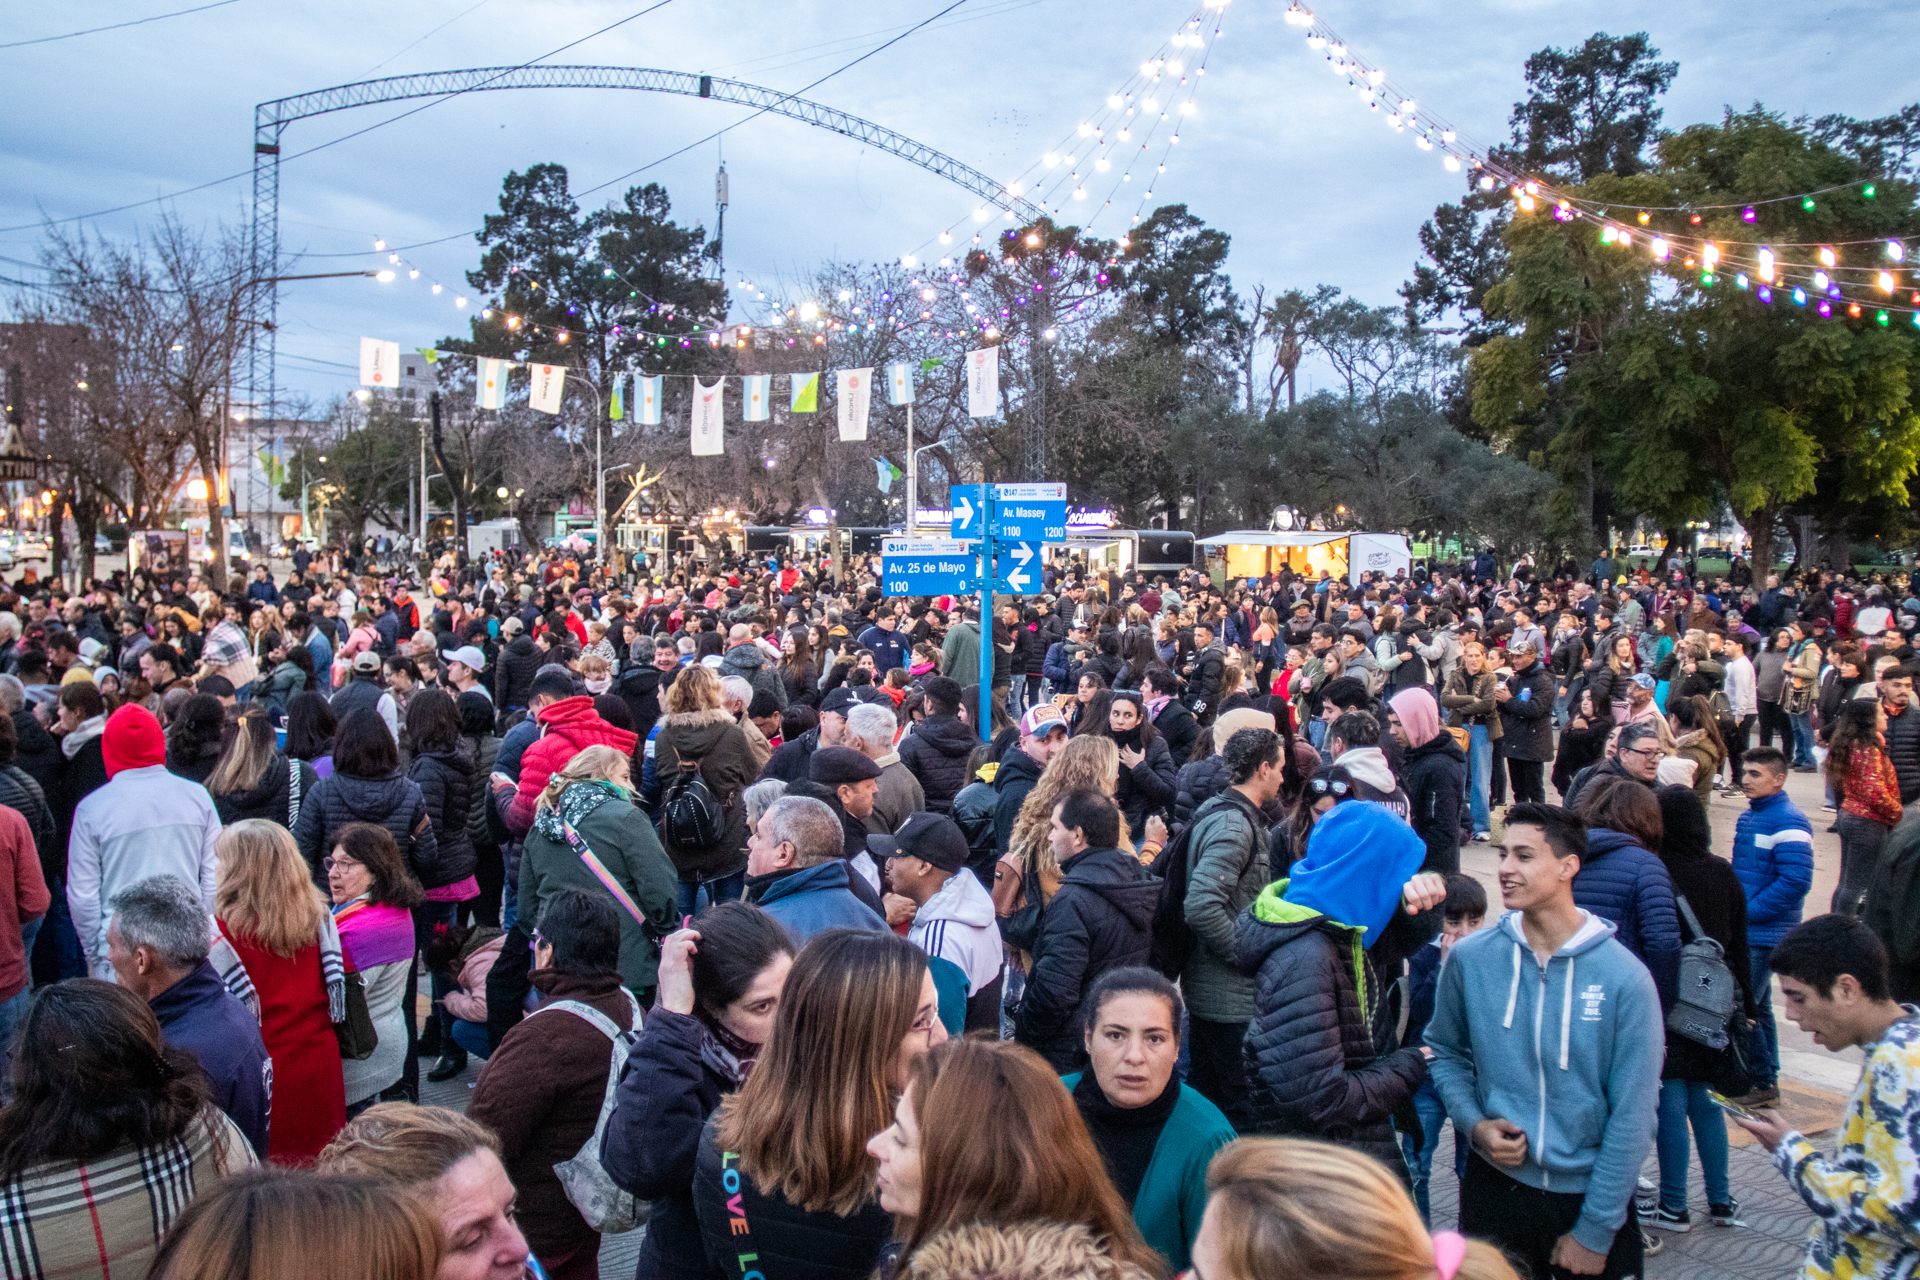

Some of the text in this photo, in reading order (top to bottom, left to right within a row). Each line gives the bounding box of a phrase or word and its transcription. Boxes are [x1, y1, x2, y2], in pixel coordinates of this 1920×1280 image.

[1003, 507, 1046, 520] Av. Massey
[1003, 526, 1064, 538] 1100 1200
[896, 544, 908, 552] 147
[889, 562, 966, 575] Av. 25 de Mayo
[889, 580, 966, 593] 100 0
[1193, 699, 1207, 713] 99
[1376, 801, 1405, 816] MAHA
[723, 1151, 750, 1236] LOVE
